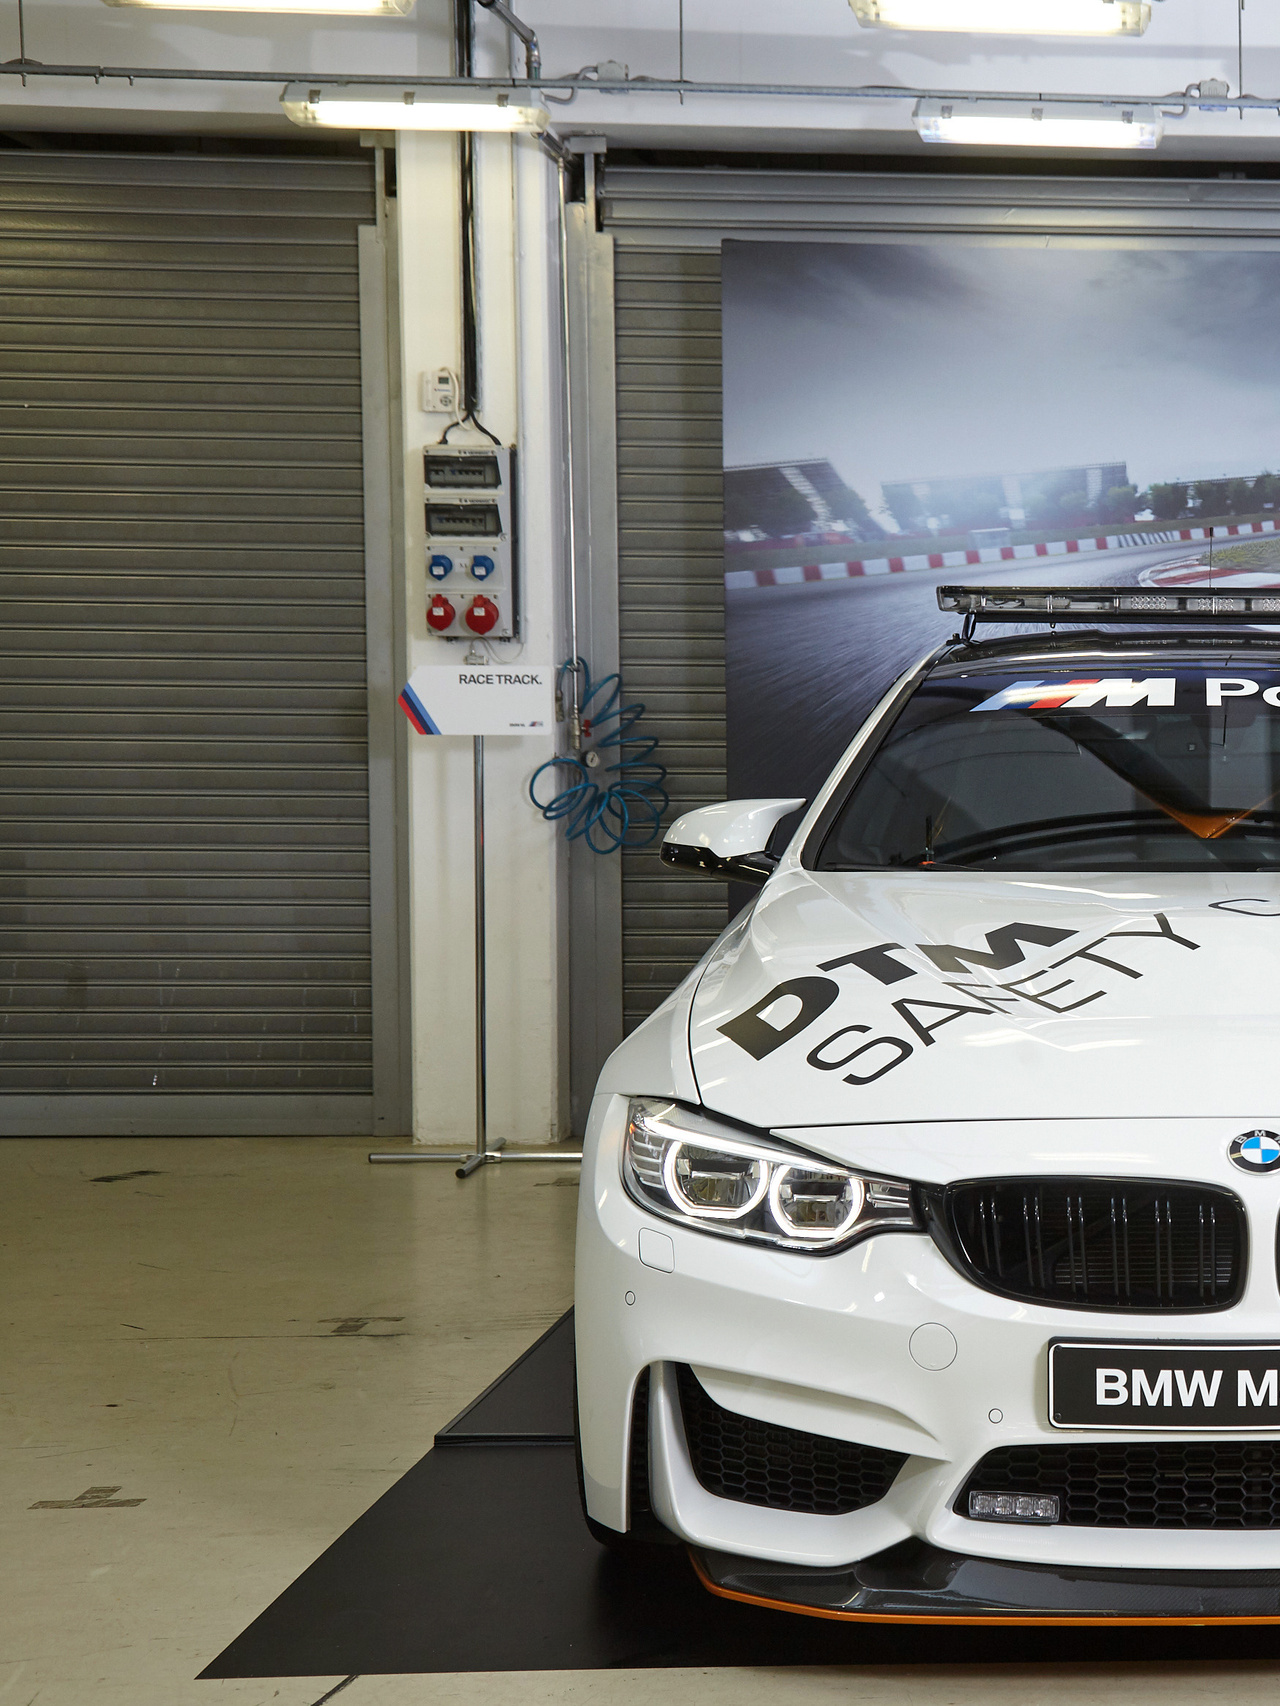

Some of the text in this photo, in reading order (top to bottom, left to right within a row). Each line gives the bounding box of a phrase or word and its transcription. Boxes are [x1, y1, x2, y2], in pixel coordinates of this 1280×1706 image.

[458, 674, 542, 685] RACE TRACK.
[716, 922, 1080, 1062] DTM
[806, 913, 1201, 1086] SAFETY
[1095, 1367, 1224, 1408] BMW
